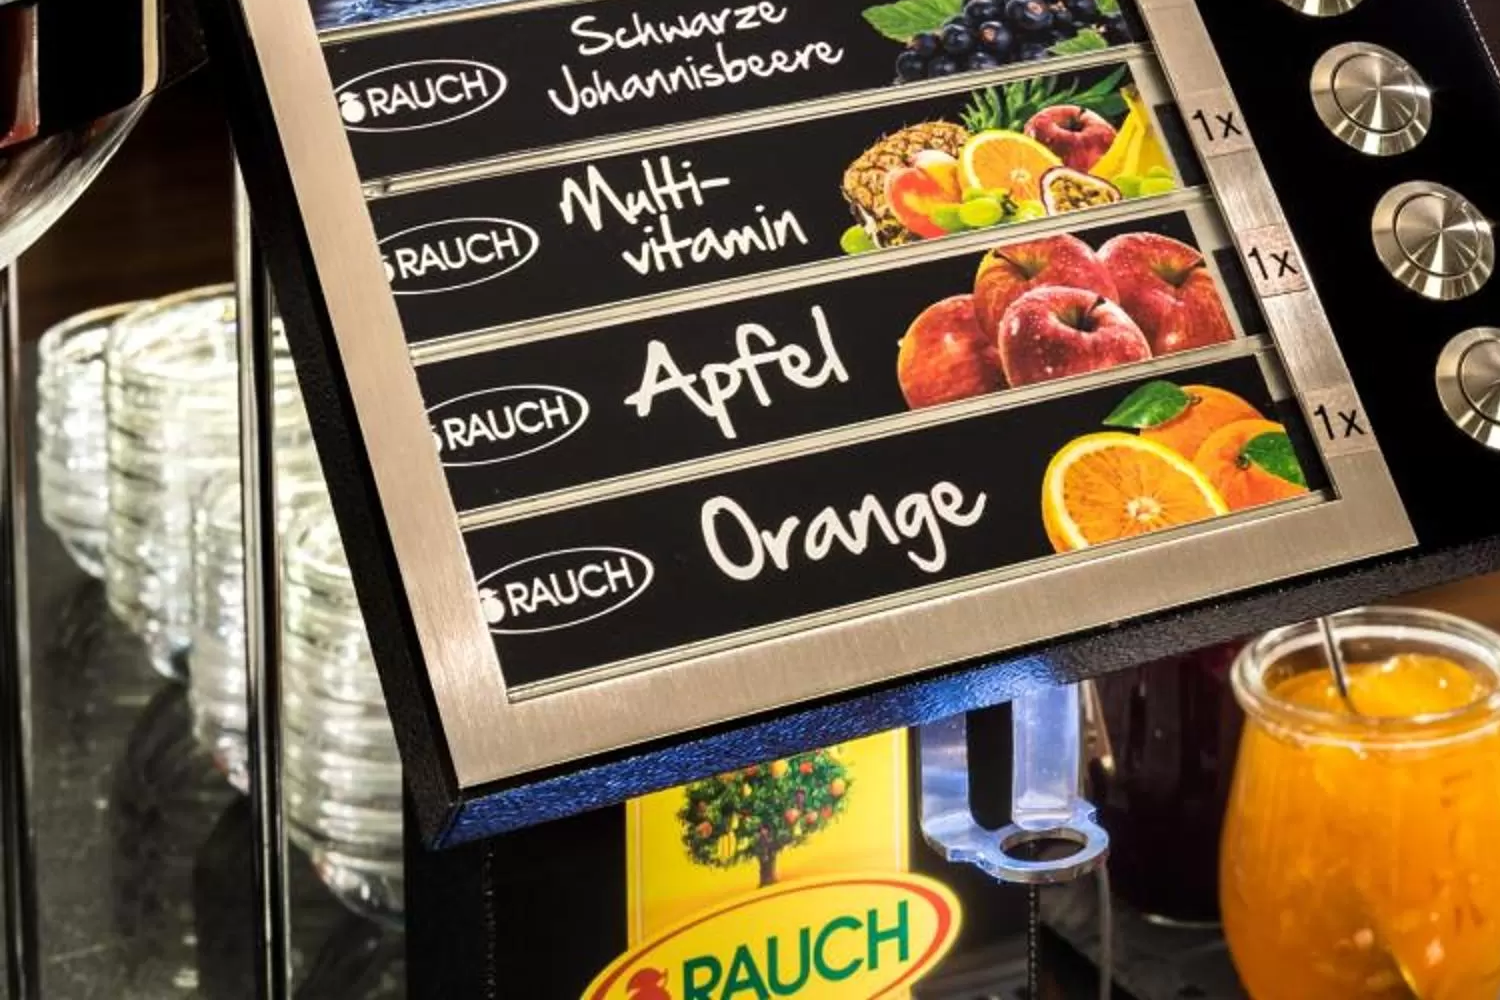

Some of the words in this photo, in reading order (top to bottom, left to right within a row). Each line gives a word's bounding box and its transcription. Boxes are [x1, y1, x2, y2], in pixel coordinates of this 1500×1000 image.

[570, 0, 787, 56] Schwarze
[367, 71, 489, 117] RAUCH
[547, 42, 844, 117] Johannisbeere
[1192, 109, 1243, 141] 1x
[559, 155, 731, 233] Multi-
[400, 231, 519, 280] RAUCH
[621, 204, 808, 276] vitamin
[1247, 246, 1299, 279] 1x
[624, 305, 850, 439] Apfel
[445, 396, 570, 450] RAUCH
[1313, 404, 1366, 440] 1x
[700, 480, 987, 582] Orange
[507, 557, 636, 616] RAUCH
[683, 900, 909, 1000] RAUCH
